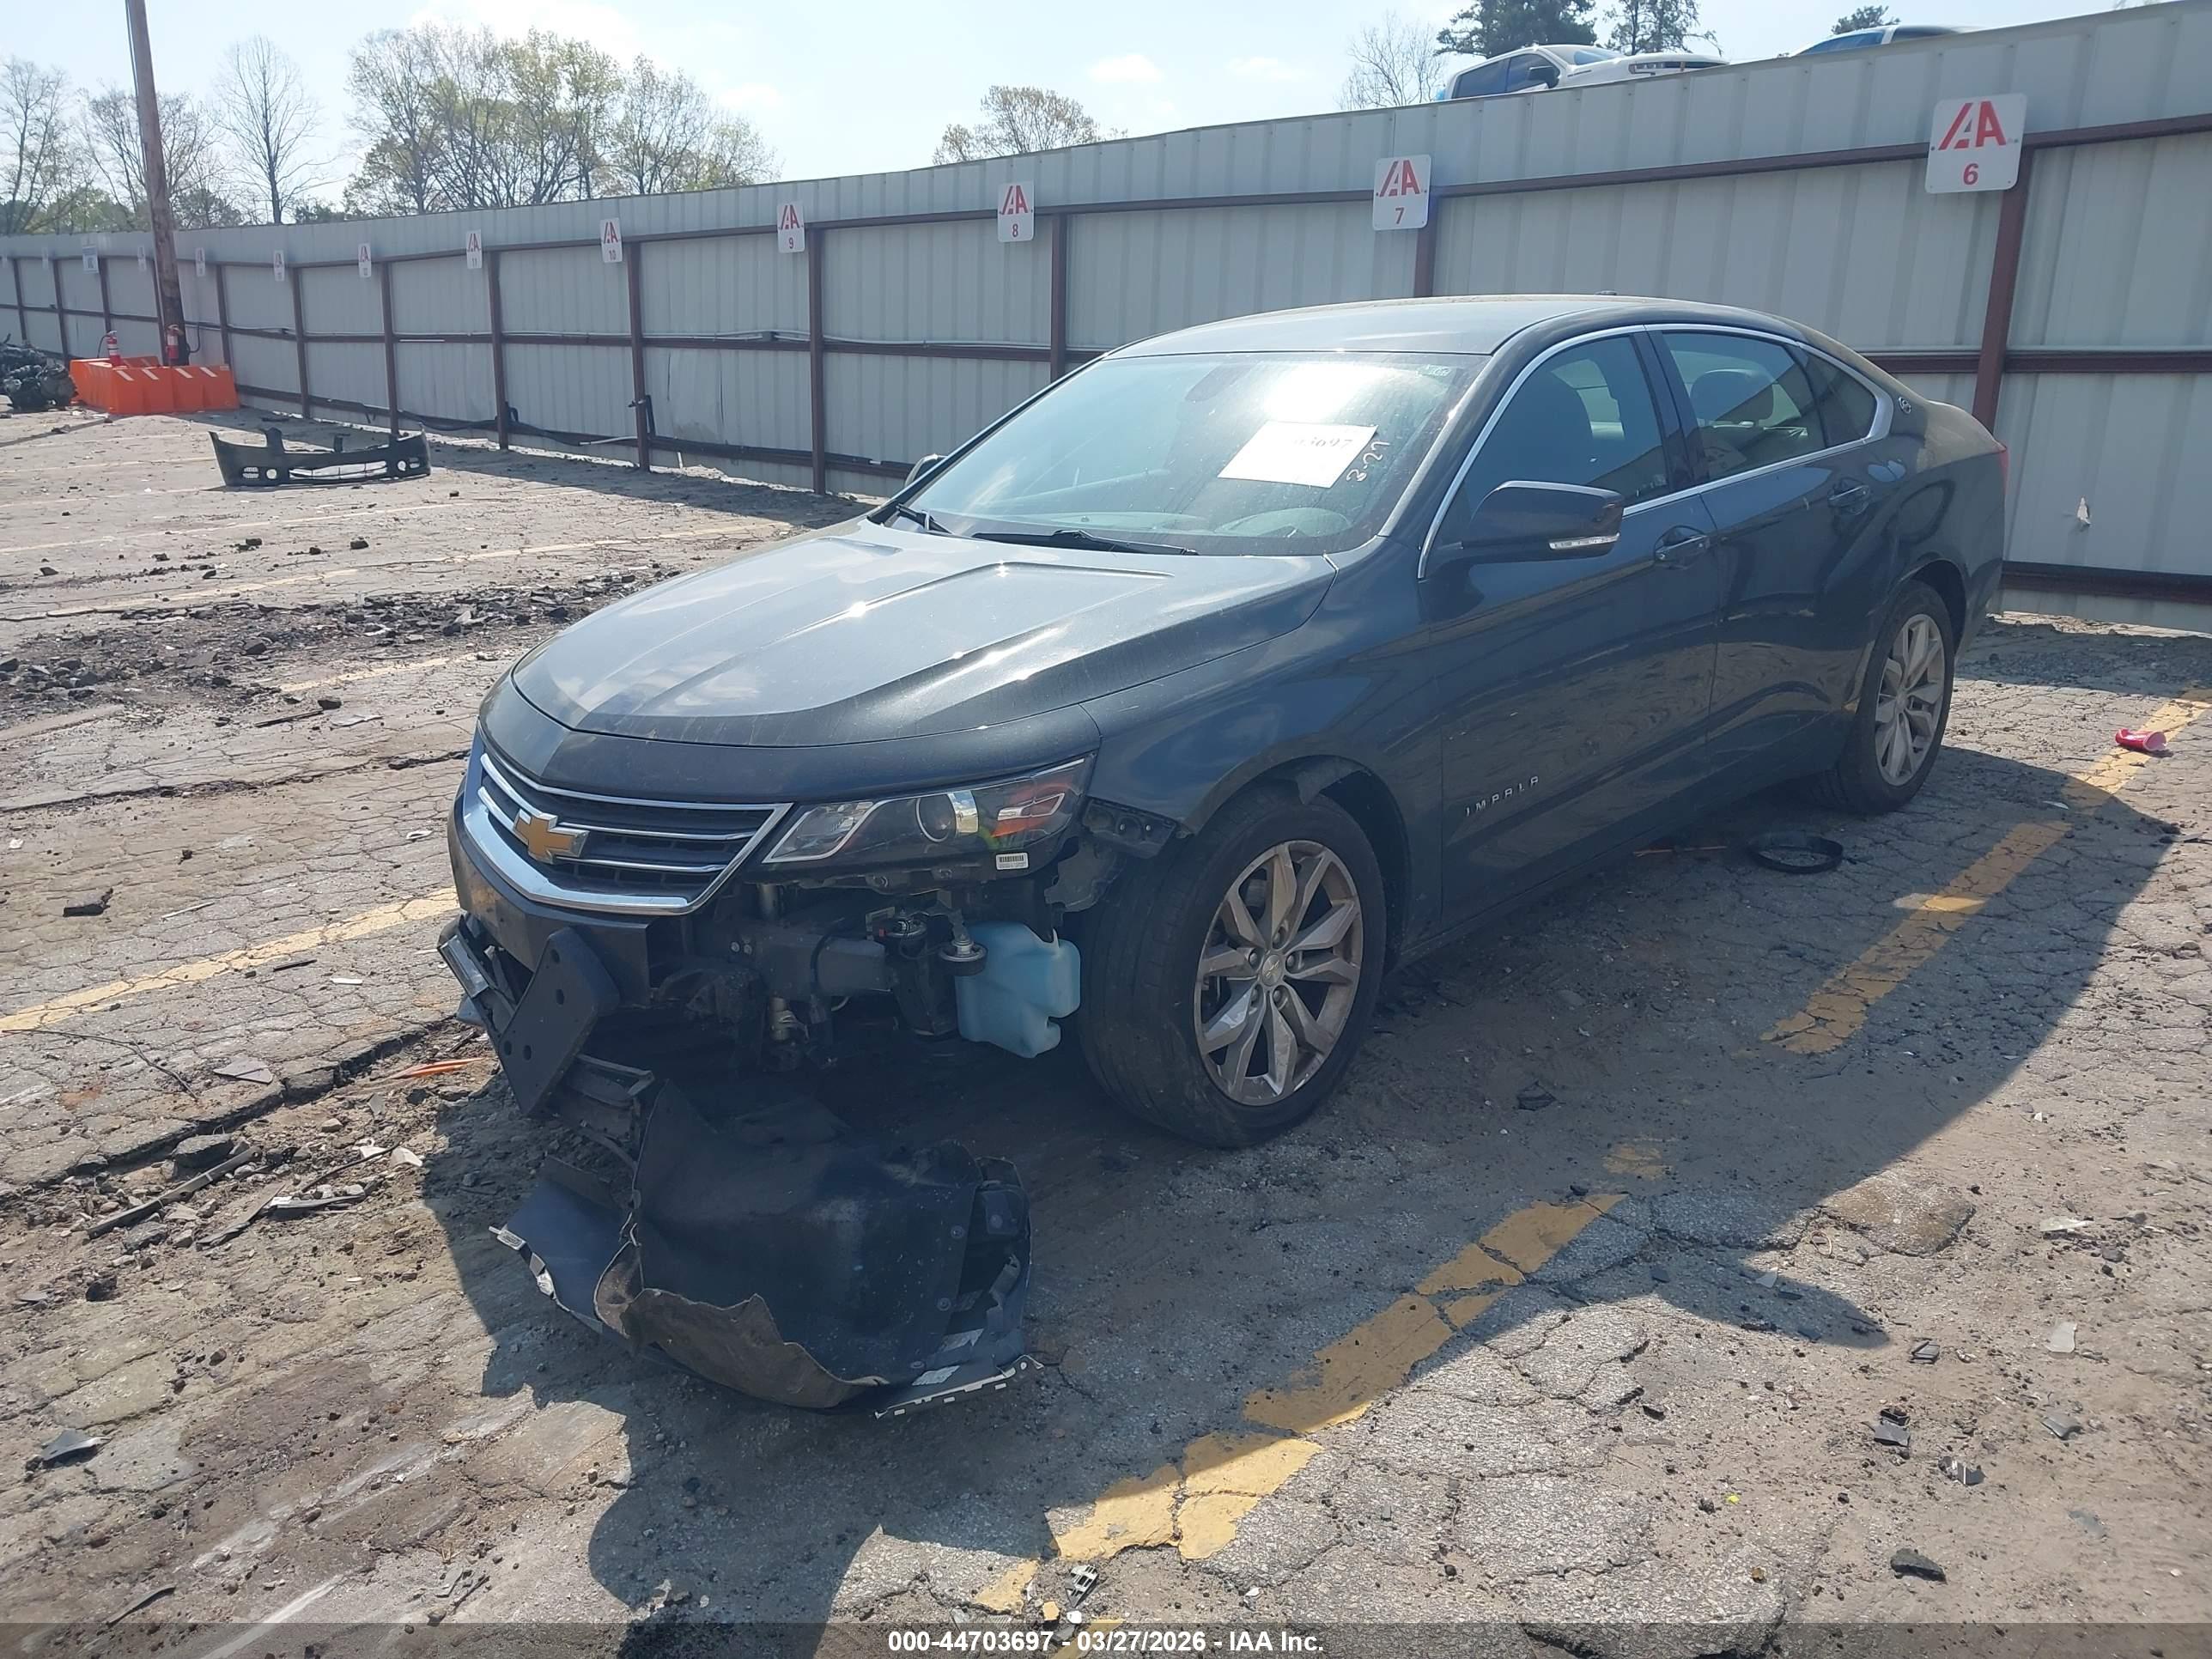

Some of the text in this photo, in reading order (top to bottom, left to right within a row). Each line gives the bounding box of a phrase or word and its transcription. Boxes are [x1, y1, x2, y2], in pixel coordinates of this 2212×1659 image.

[1963, 163, 1978, 185] 6
[1395, 207, 1405, 224] 7
[1012, 223, 1018, 237] 8
[788, 237, 794, 249] 9
[1465, 775, 1539, 817] IMPALA
